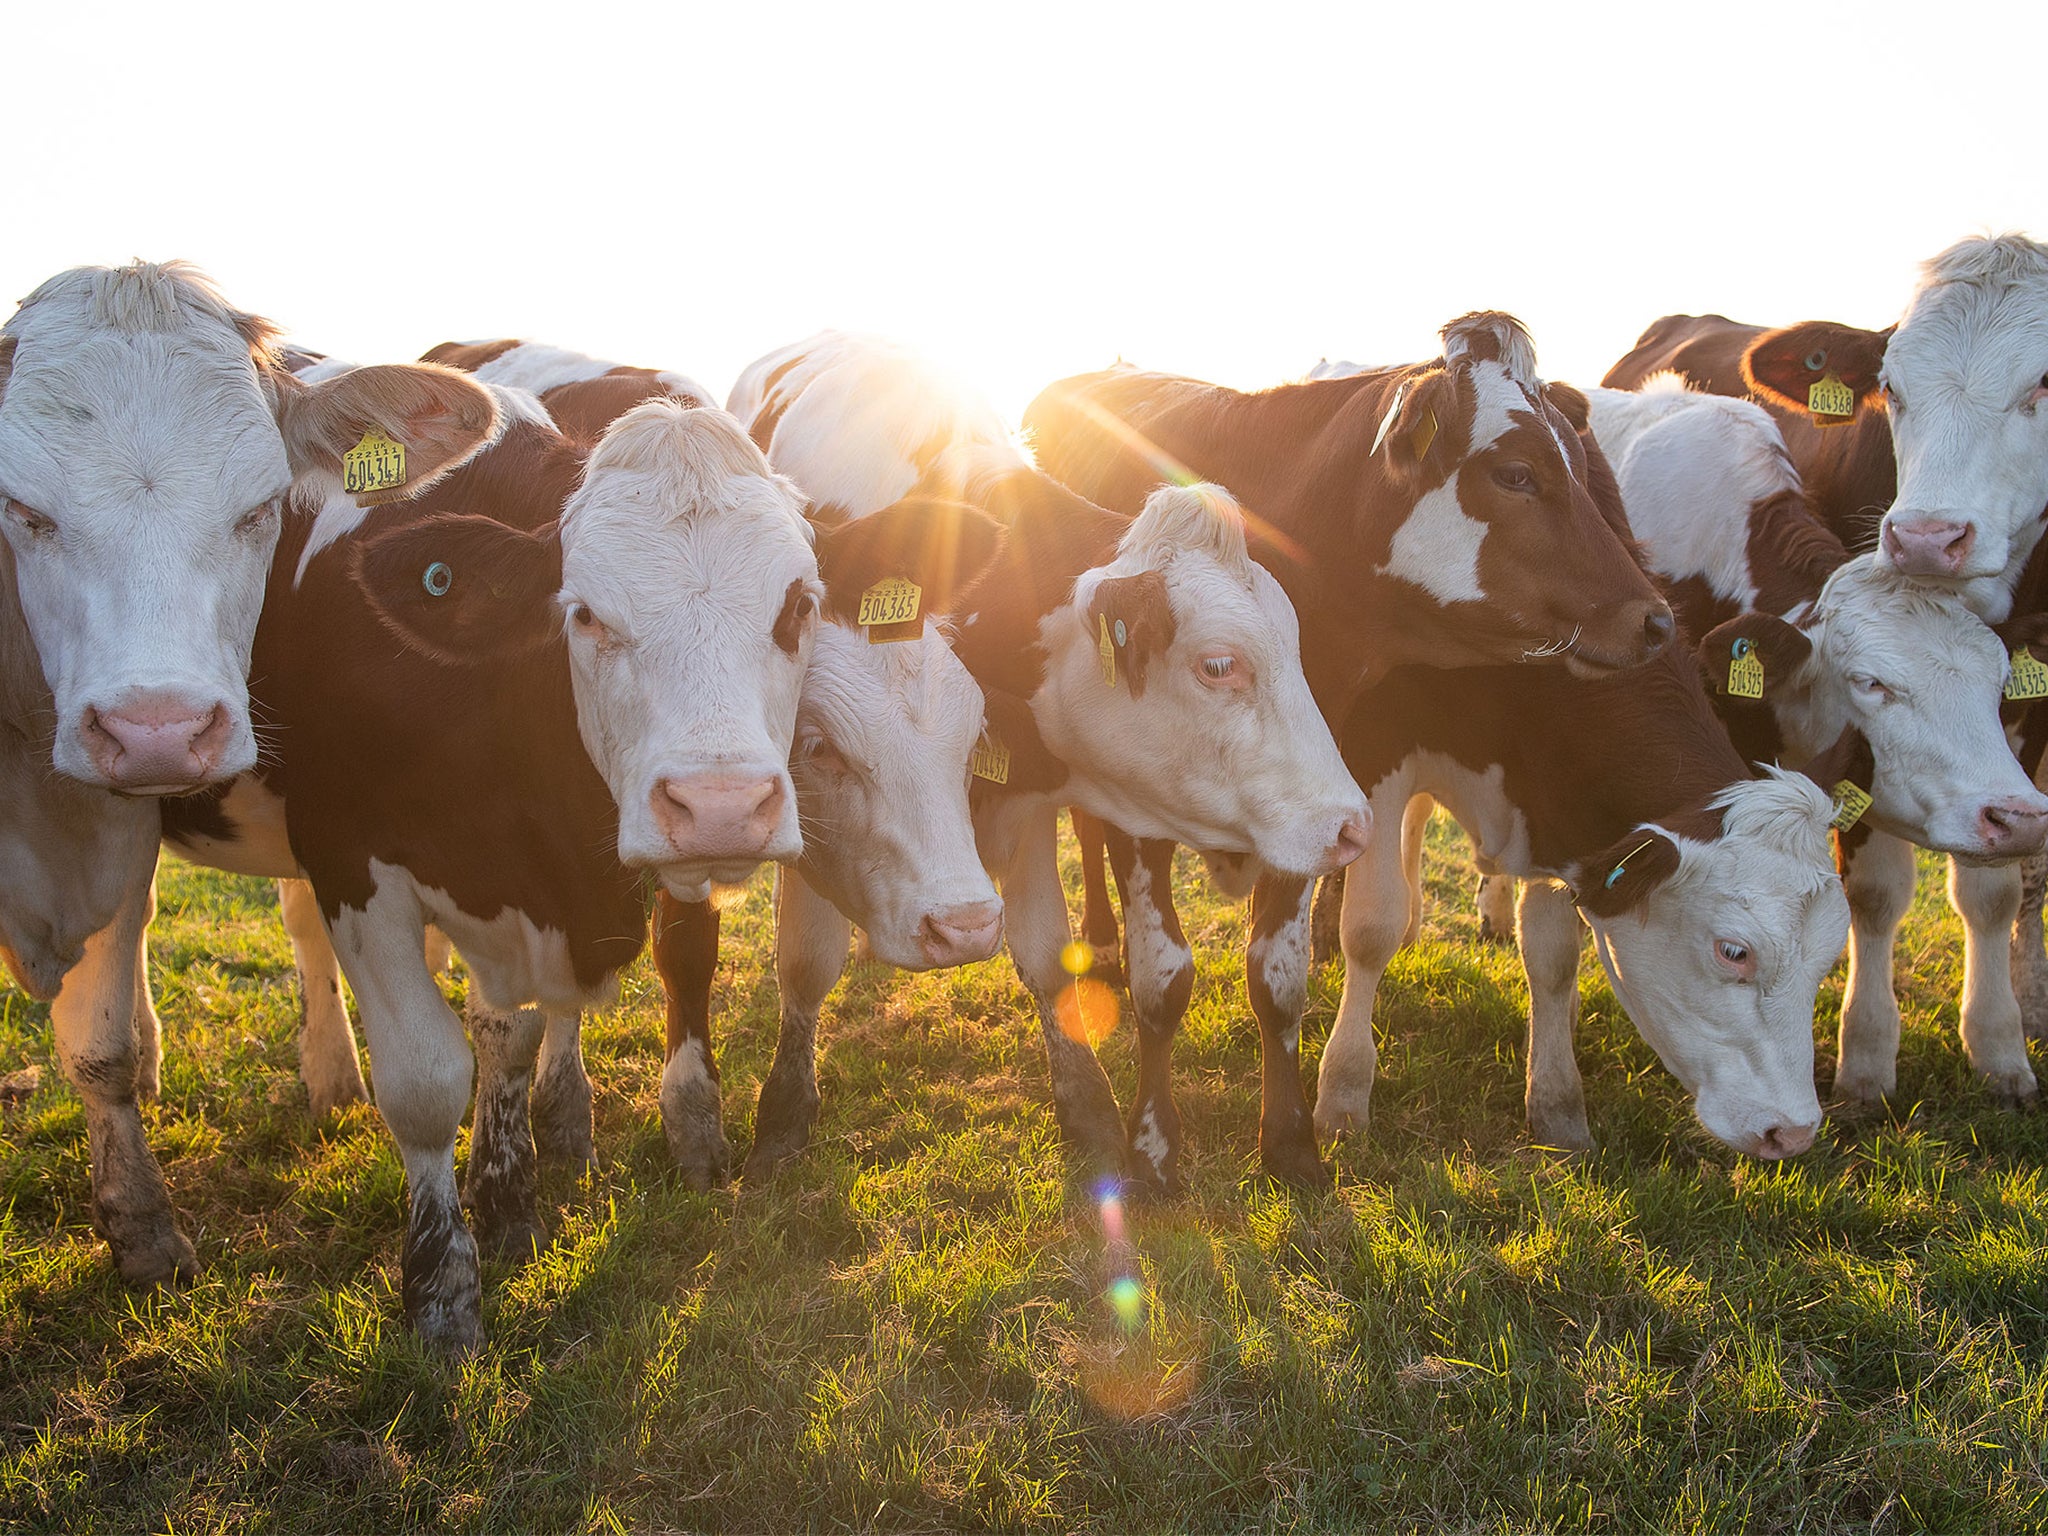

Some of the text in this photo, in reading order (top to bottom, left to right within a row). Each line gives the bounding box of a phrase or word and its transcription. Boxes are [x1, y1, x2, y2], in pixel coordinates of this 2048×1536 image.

[1812, 392, 1852, 414] 604368
[347, 446, 397, 460] 222111
[347, 454, 401, 488] 604347
[860, 595, 915, 622] 304365
[1731, 668, 1762, 695] 504325
